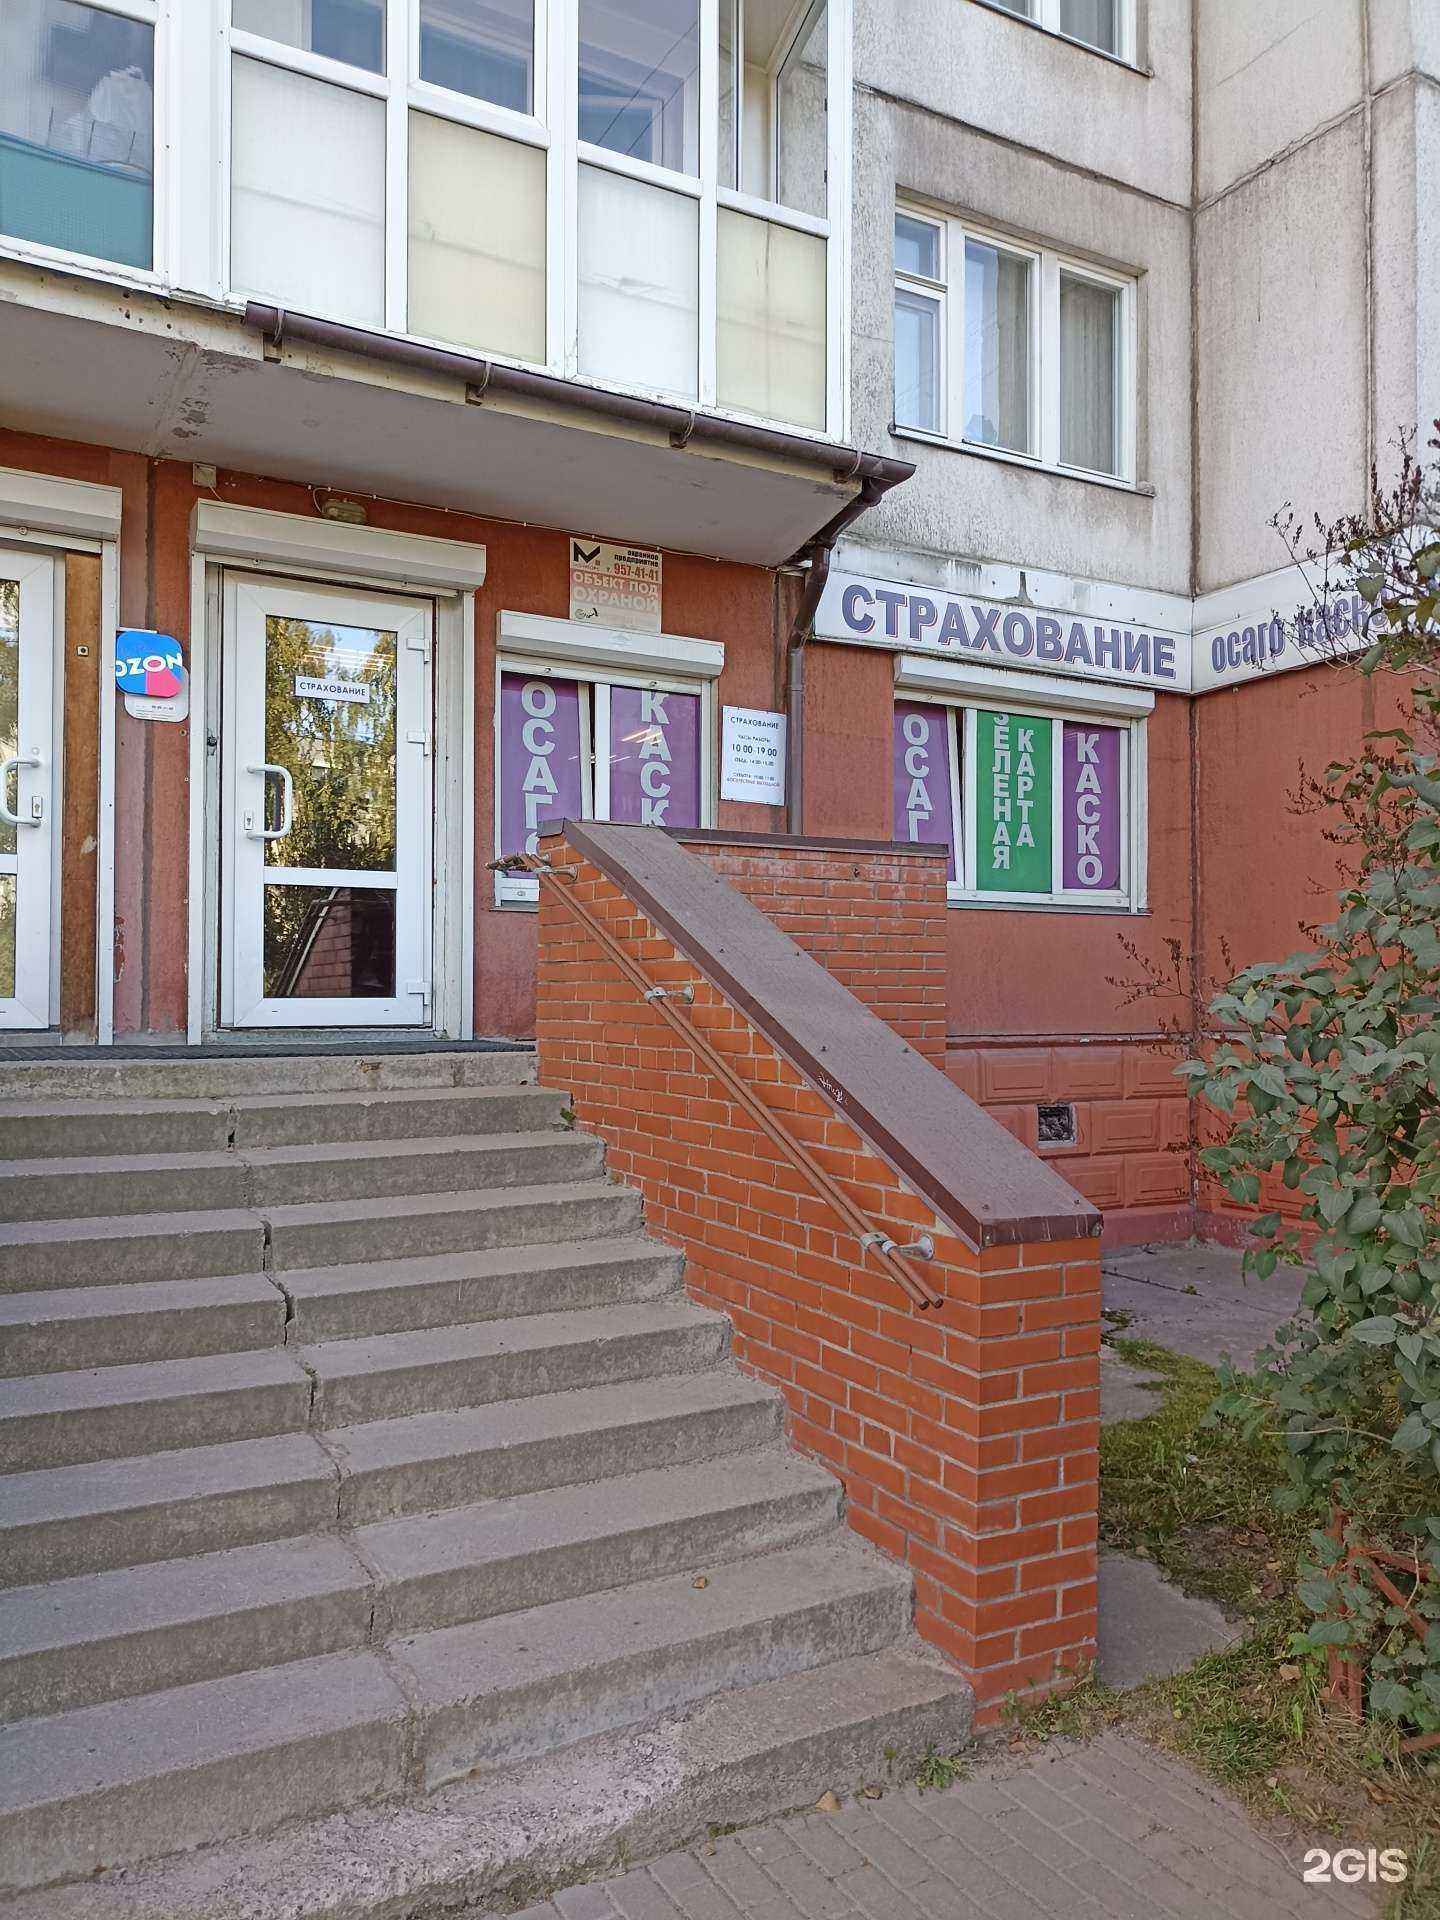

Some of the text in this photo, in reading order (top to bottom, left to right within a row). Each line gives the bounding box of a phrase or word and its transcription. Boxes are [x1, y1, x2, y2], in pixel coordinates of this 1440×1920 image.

[573, 571, 659, 598] ОБЪЕКТ ПОД
[574, 586, 658, 610] ОХРАНОЙ
[613, 562, 659, 581] 957-41-41
[841, 584, 1176, 679] СТРАХОВАНИЕ
[299, 681, 366, 696] СТРАХОВАНИЕ
[731, 716, 779, 729] СТРАХОВАНИЕ
[638, 690, 672, 827] КАСК
[902, 713, 933, 842] ОСАГ
[1016, 728, 1036, 848] КАРТА
[1075, 732, 1103, 886] КАСКО
